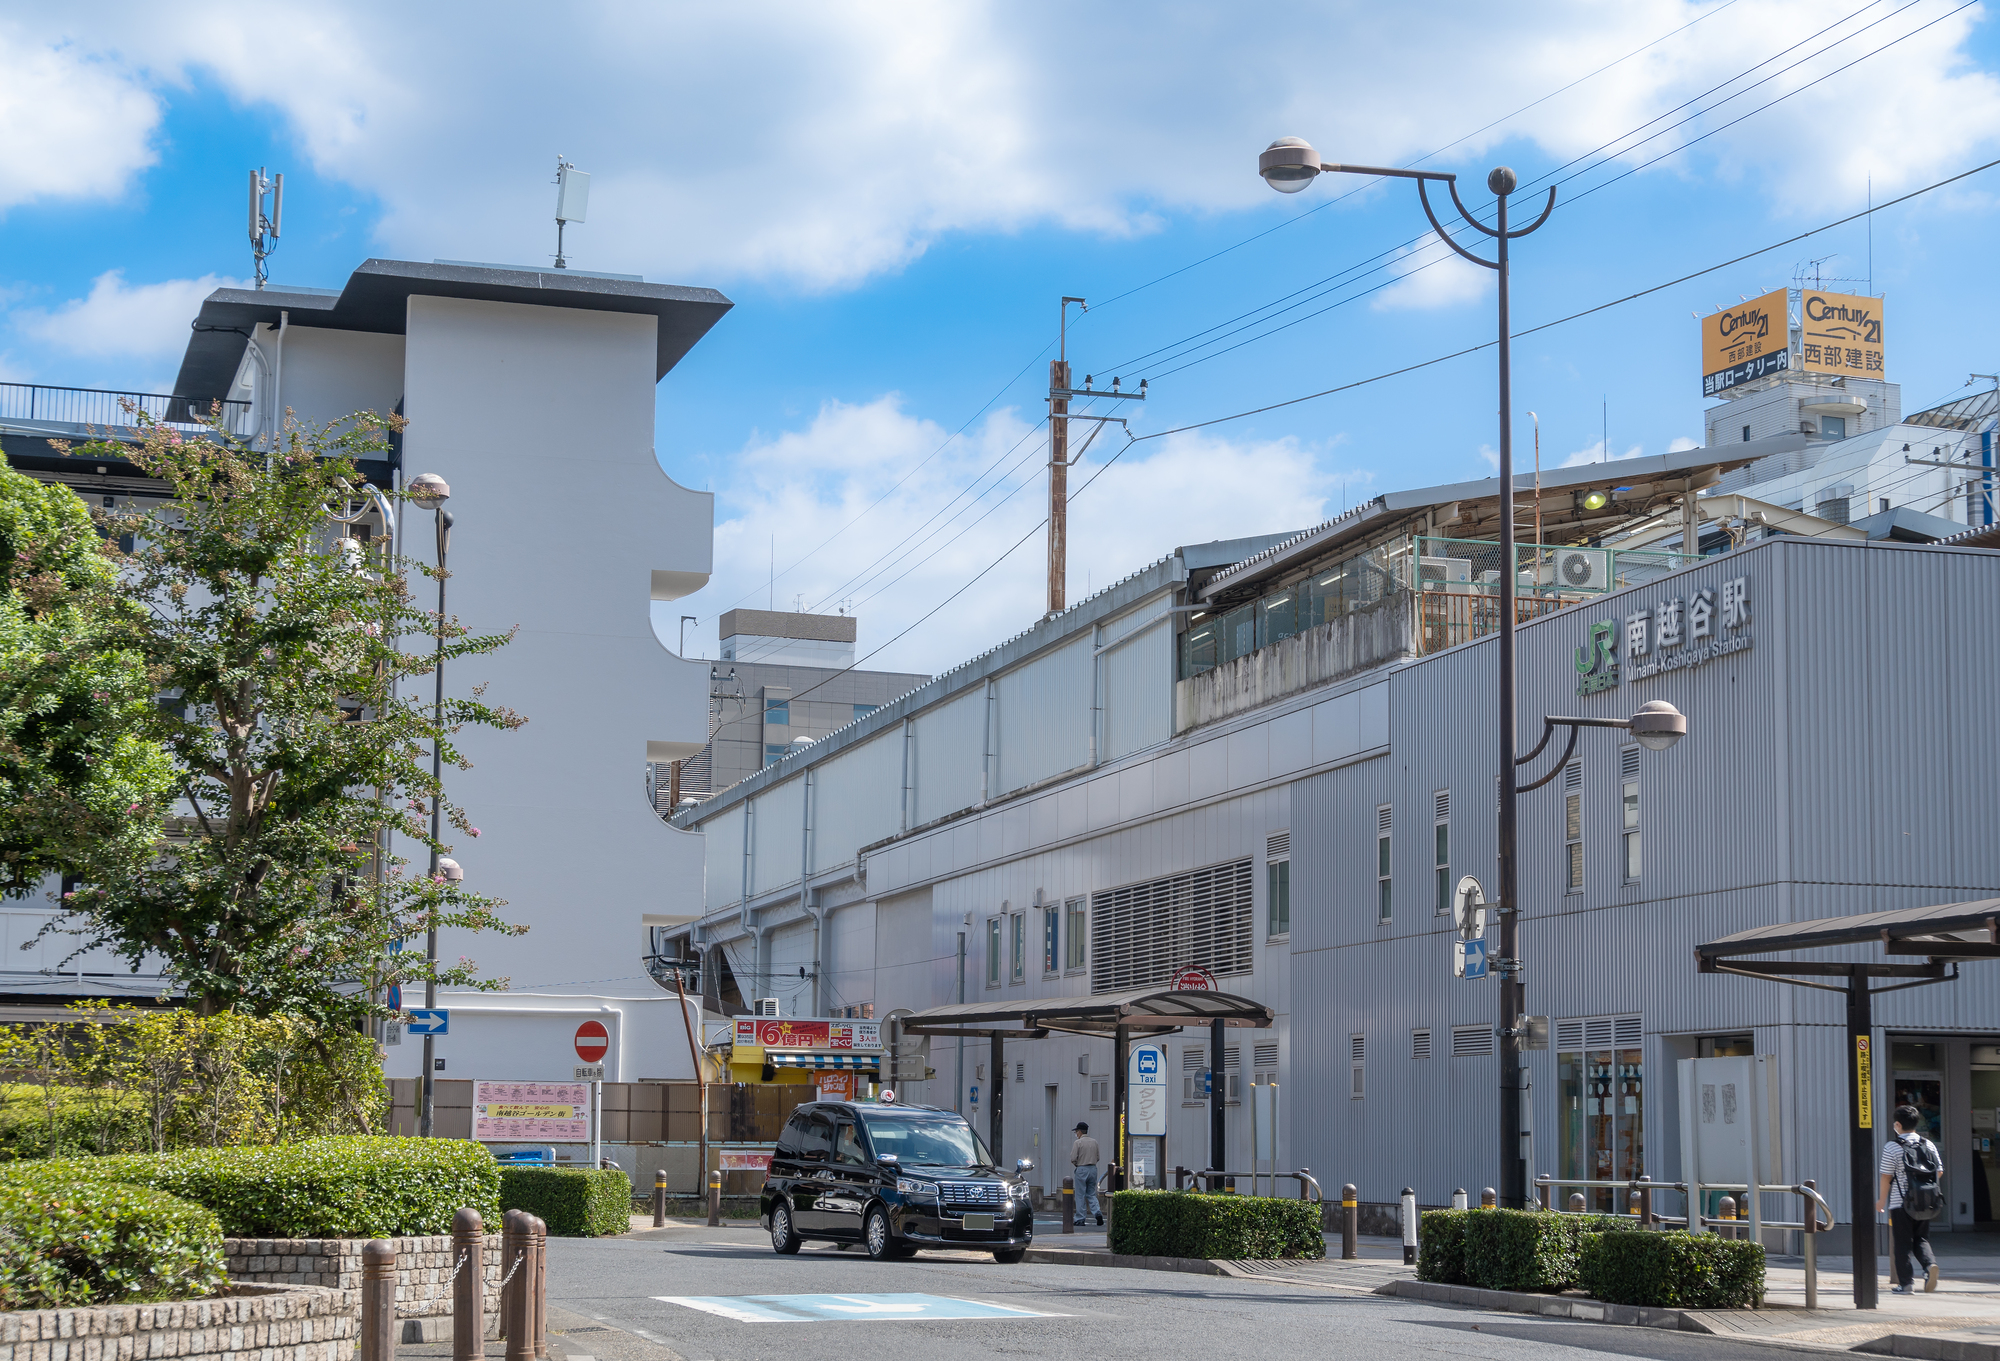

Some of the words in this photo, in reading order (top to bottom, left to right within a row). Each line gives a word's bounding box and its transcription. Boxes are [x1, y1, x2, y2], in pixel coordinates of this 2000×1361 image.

[1719, 307, 1761, 337] Century
[1757, 313, 1769, 339] 21
[1806, 296, 1870, 327] Century
[1863, 318, 1881, 343] 21
[1728, 341, 1762, 364] 西部建設
[1804, 343, 1884, 372] 西部建設
[1705, 350, 1788, 395] 当駅ロータリー内
[1626, 575, 1752, 657] 南越谷駅
[1575, 619, 1617, 674] JR
[1627, 646, 1710, 682] Minami-Koshigaya
[1711, 635, 1748, 658] Station
[1576, 669, 1616, 697] JR東日本
[761, 1021, 814, 1047] 6億円
[830, 1038, 852, 1047] 宝くじ
[819, 1074, 849, 1084] ハロウィン
[823, 1083, 846, 1091] ジャンボ
[1140, 1074, 1157, 1083] Taxi
[496, 1110, 566, 1118] 南越谷ゴールデン街
[1139, 1088, 1157, 1132] タクシー
